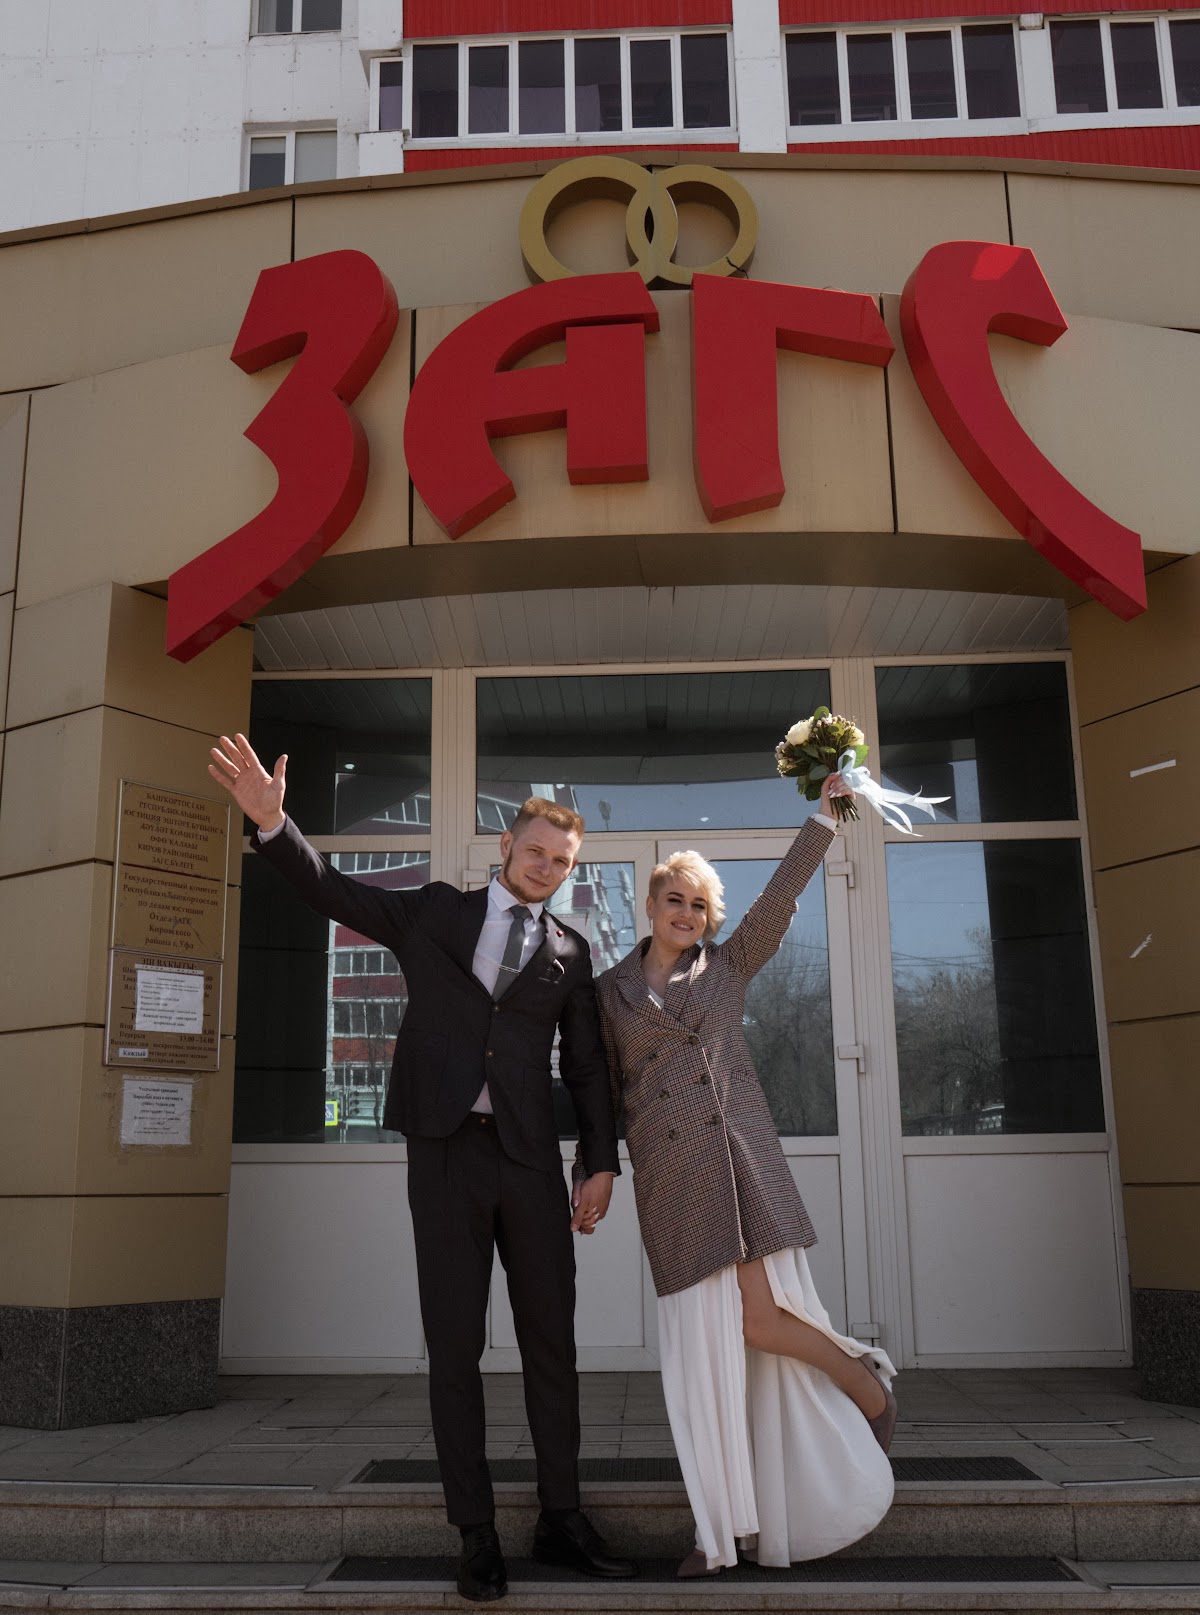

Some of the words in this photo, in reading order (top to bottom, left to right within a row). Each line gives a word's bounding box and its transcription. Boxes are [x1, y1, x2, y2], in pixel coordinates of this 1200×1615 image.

[167, 240, 1147, 662] ЗАГС
[124, 872, 188, 890] Государственный
[189, 885, 218, 895] комитет
[122, 884, 168, 898] Республики
[149, 902, 170, 910] делам
[149, 912, 172, 922] Отдел
[148, 924, 192, 937] Кировского
[180, 940, 194, 951] Уфа
